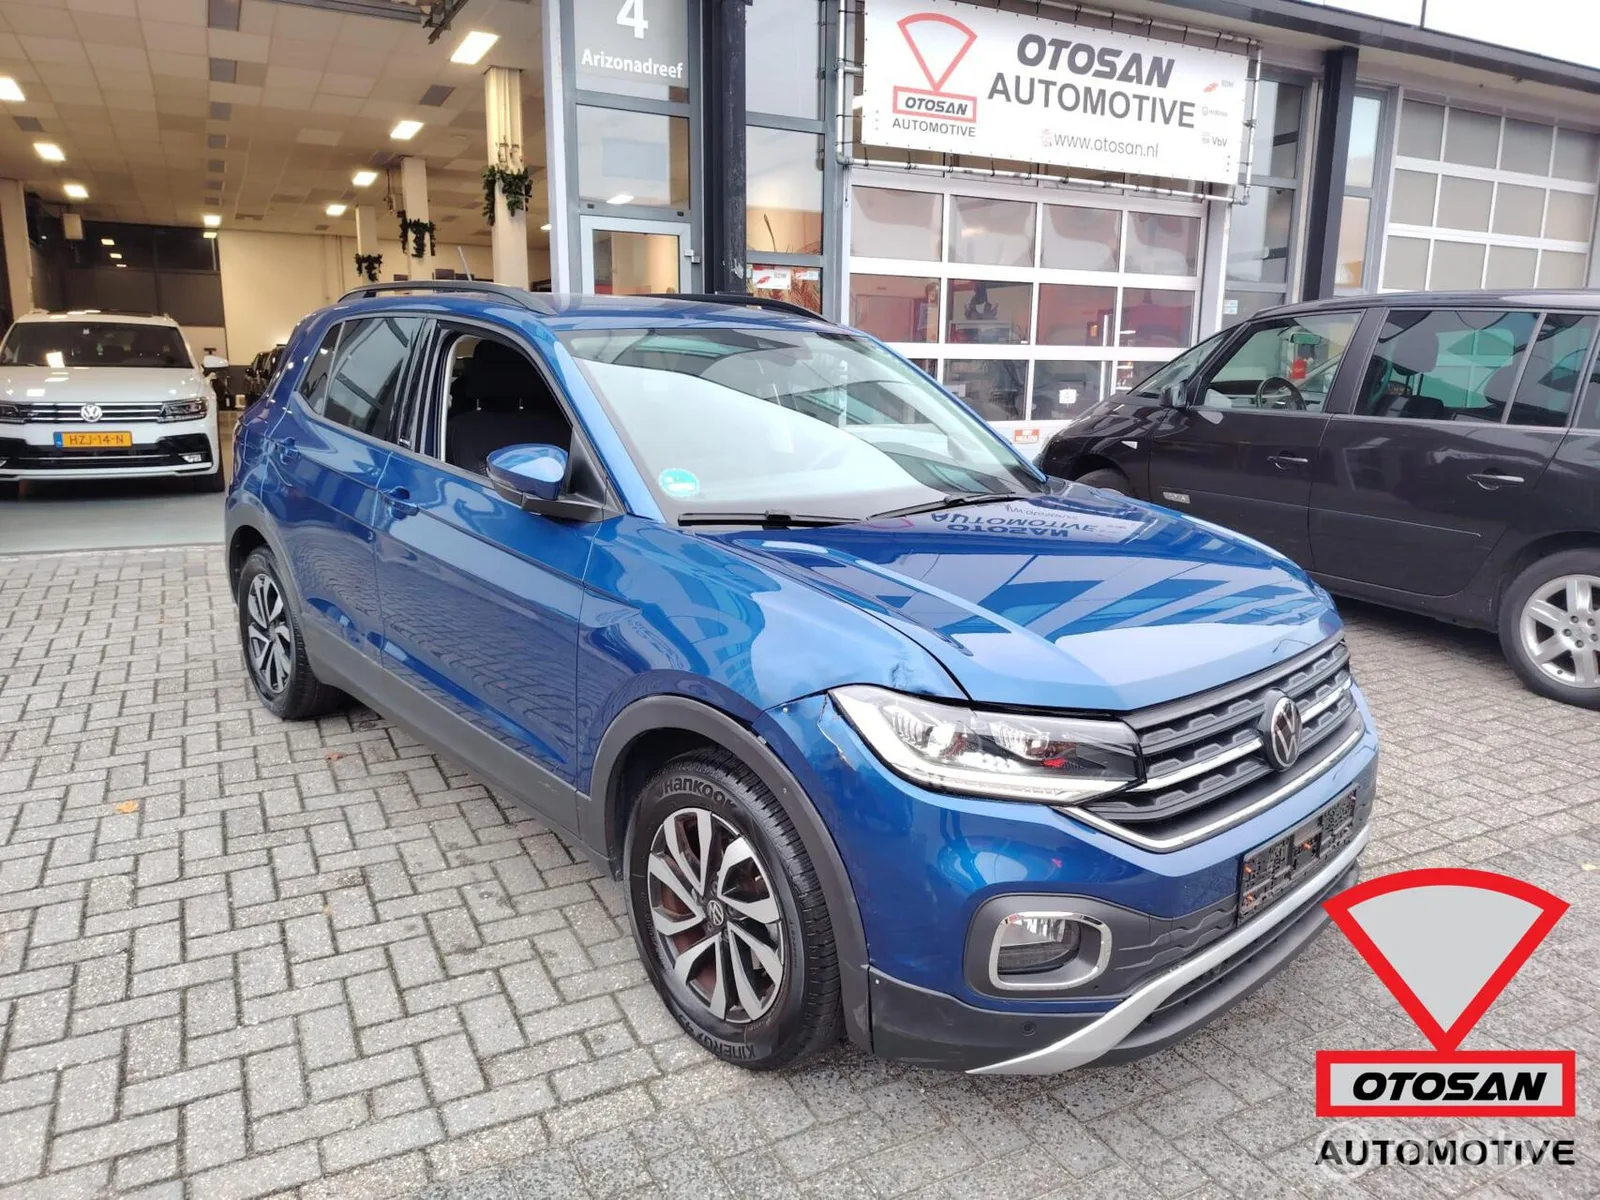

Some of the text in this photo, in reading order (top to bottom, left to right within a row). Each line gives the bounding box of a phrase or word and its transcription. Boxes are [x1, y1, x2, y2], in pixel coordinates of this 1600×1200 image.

[616, 0, 649, 39] 4
[581, 48, 683, 79] Arizonadreef
[1017, 33, 1175, 89] OTOSAN
[905, 96, 968, 116] OTOSAN
[988, 72, 1196, 129] AUTOMOTIVE
[892, 118, 976, 137] AUTOMOTIVE
[1054, 133, 1158, 158] www.otosan.nl
[69, 434, 124, 445] HZJ-14-N
